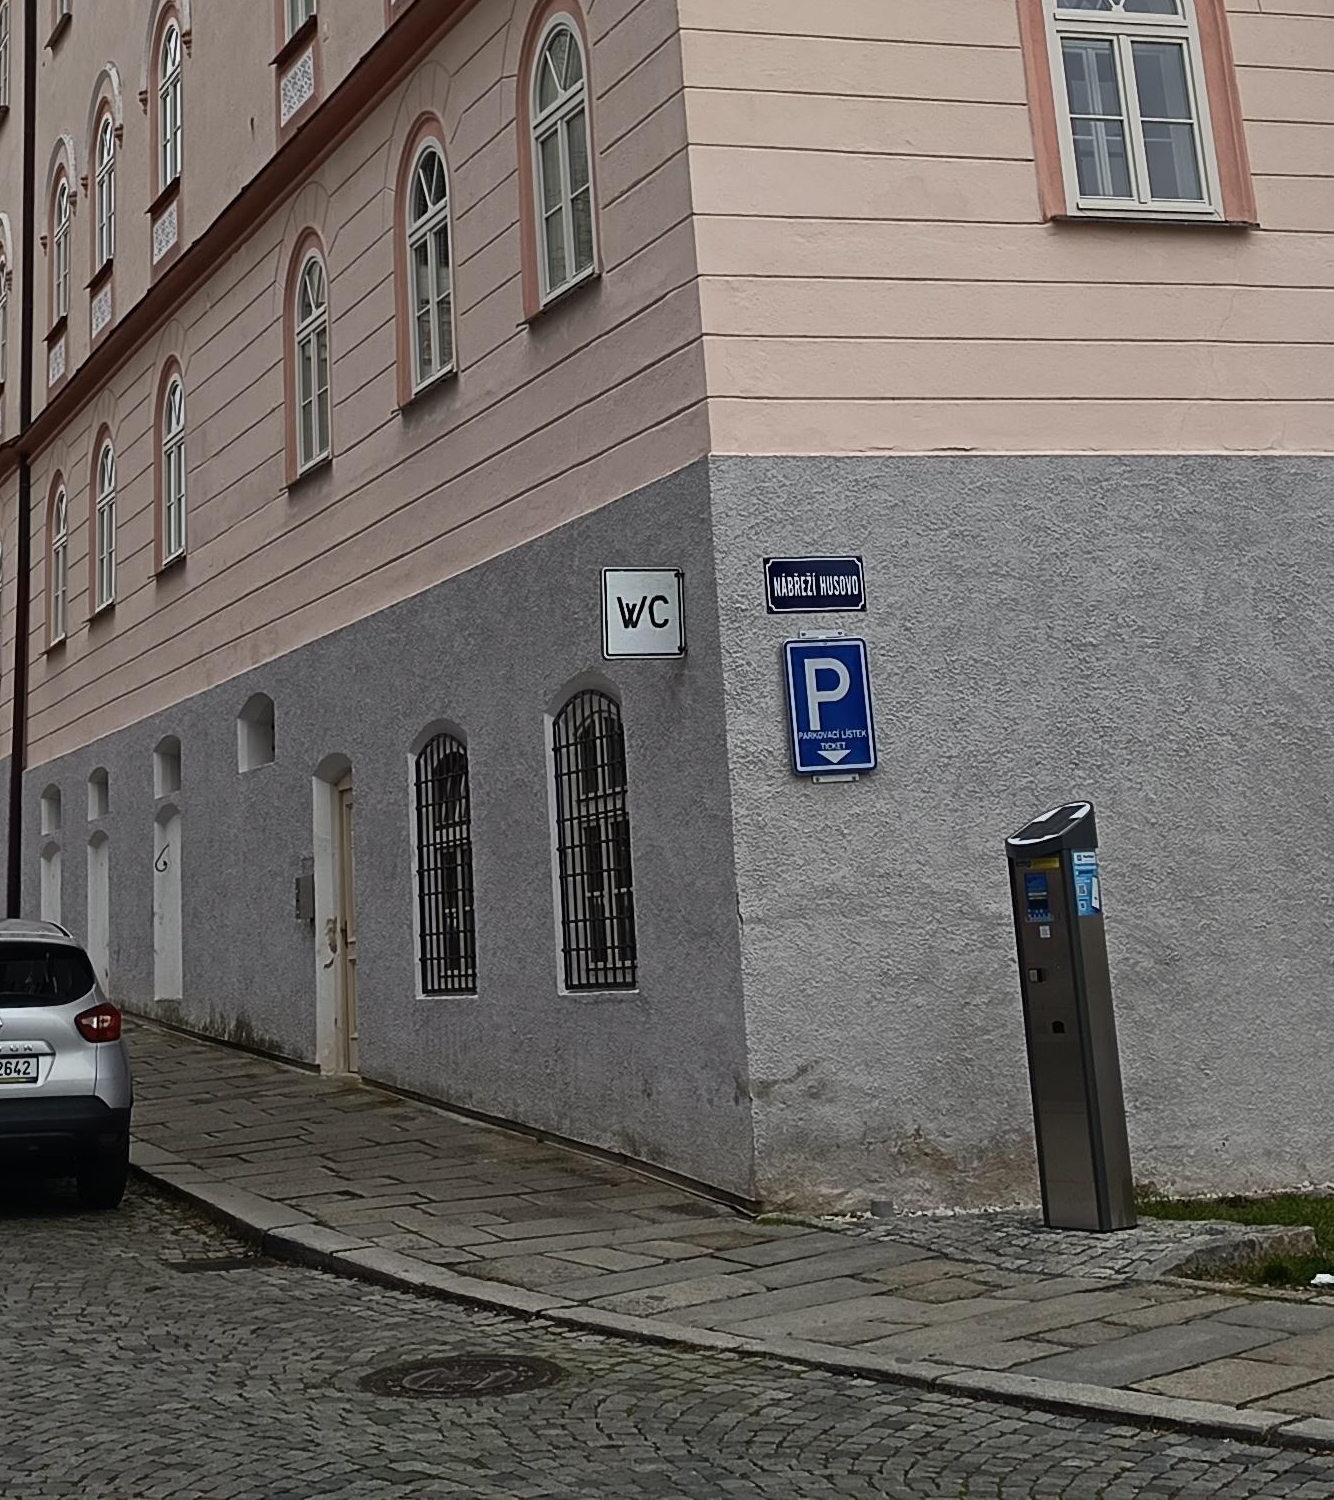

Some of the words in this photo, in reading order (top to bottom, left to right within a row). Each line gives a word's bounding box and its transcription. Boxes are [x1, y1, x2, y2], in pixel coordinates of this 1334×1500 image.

[773, 572, 817, 597] NÁBŘEŽÍ
[819, 575, 859, 596] HUSOVO
[617, 595, 669, 629] WC
[804, 657, 851, 731] P
[798, 729, 840, 740] PARKOVACÍ
[841, 728, 868, 739] LÍSTEK
[820, 741, 847, 750] TICKET
